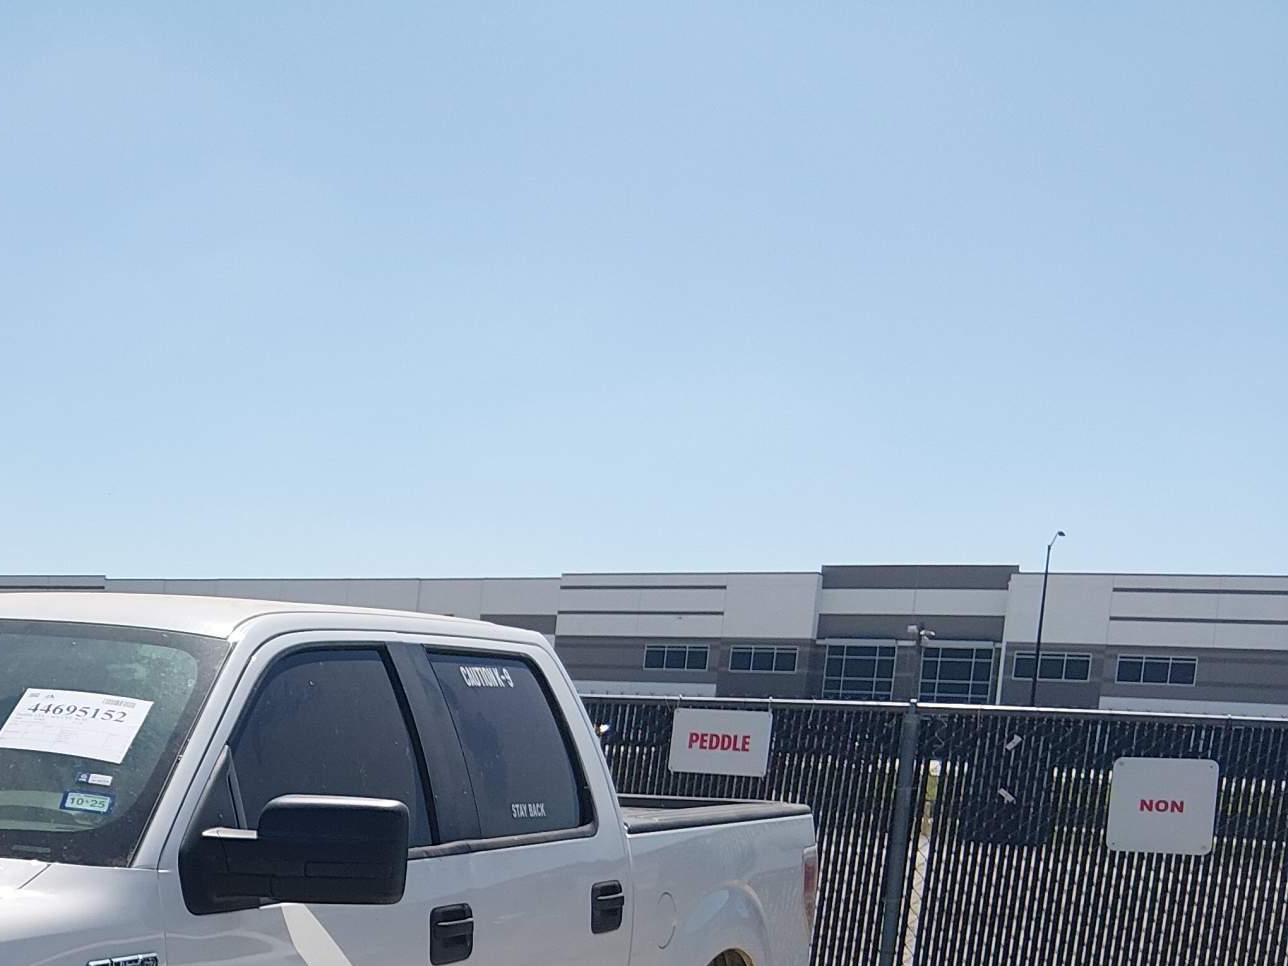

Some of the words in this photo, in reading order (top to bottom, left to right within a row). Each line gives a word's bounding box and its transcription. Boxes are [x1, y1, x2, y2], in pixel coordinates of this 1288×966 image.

[27, 702, 128, 723] 44695152
[687, 732, 751, 752] PEDDLE
[511, 803, 527, 818] STAY
[527, 802, 546, 817] BACK
[1139, 799, 1184, 813] NON
